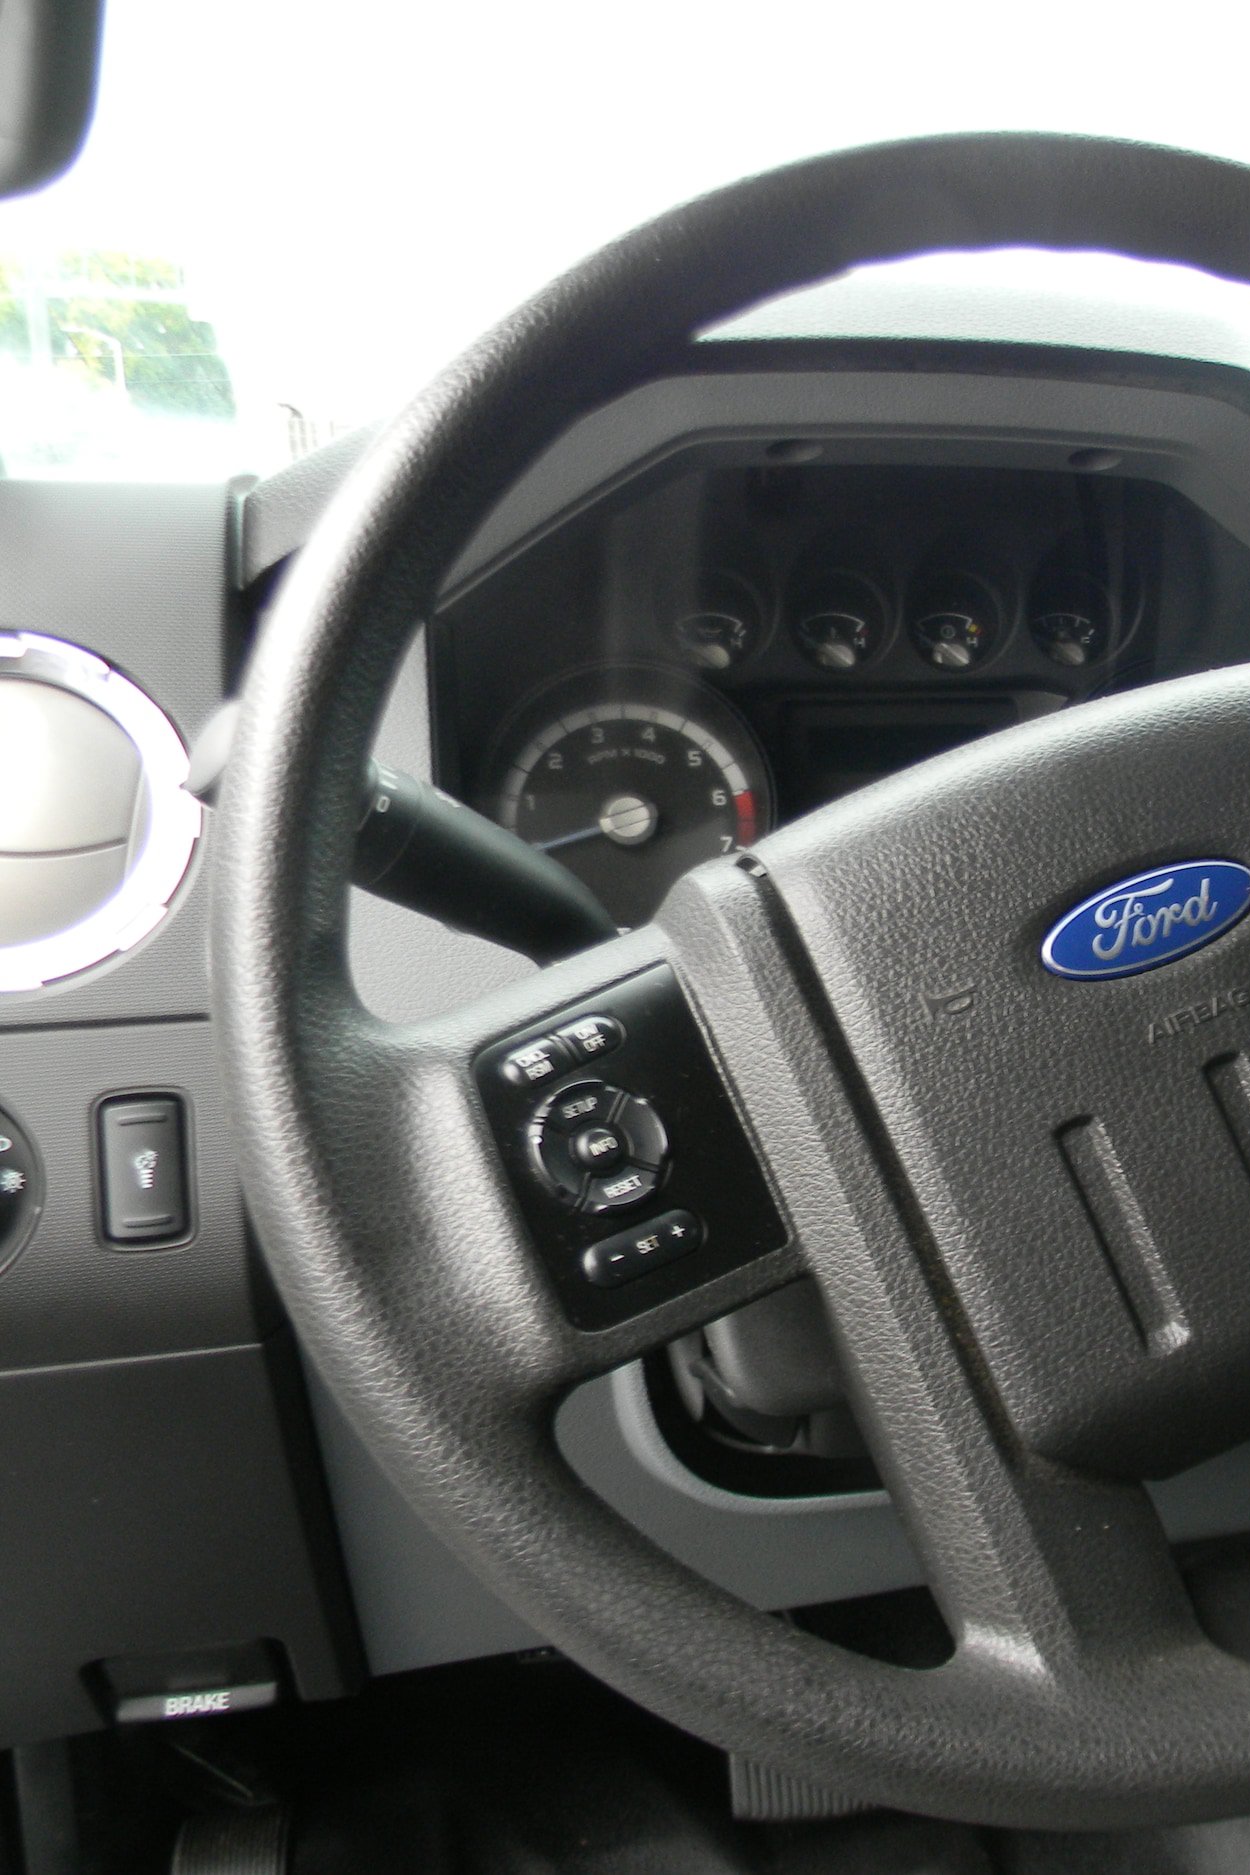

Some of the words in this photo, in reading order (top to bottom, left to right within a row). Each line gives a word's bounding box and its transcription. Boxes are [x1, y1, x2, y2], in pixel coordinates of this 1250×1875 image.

[591, 728, 604, 744] 3
[641, 727, 656, 742] 4
[549, 753, 563, 770] 2
[687, 750, 702, 767] 5
[711, 789, 726, 806] 6
[720, 836, 733, 852] 7
[1092, 878, 1218, 959] Ford
[1145, 988, 1250, 1044] AIRBAG
[583, 1034, 606, 1053] OFF
[563, 1097, 598, 1119] SETUP
[589, 1136, 619, 1157] INFO
[603, 1175, 642, 1198] RESET
[636, 1235, 661, 1255] SET
[165, 1692, 230, 1715] BRAKE
